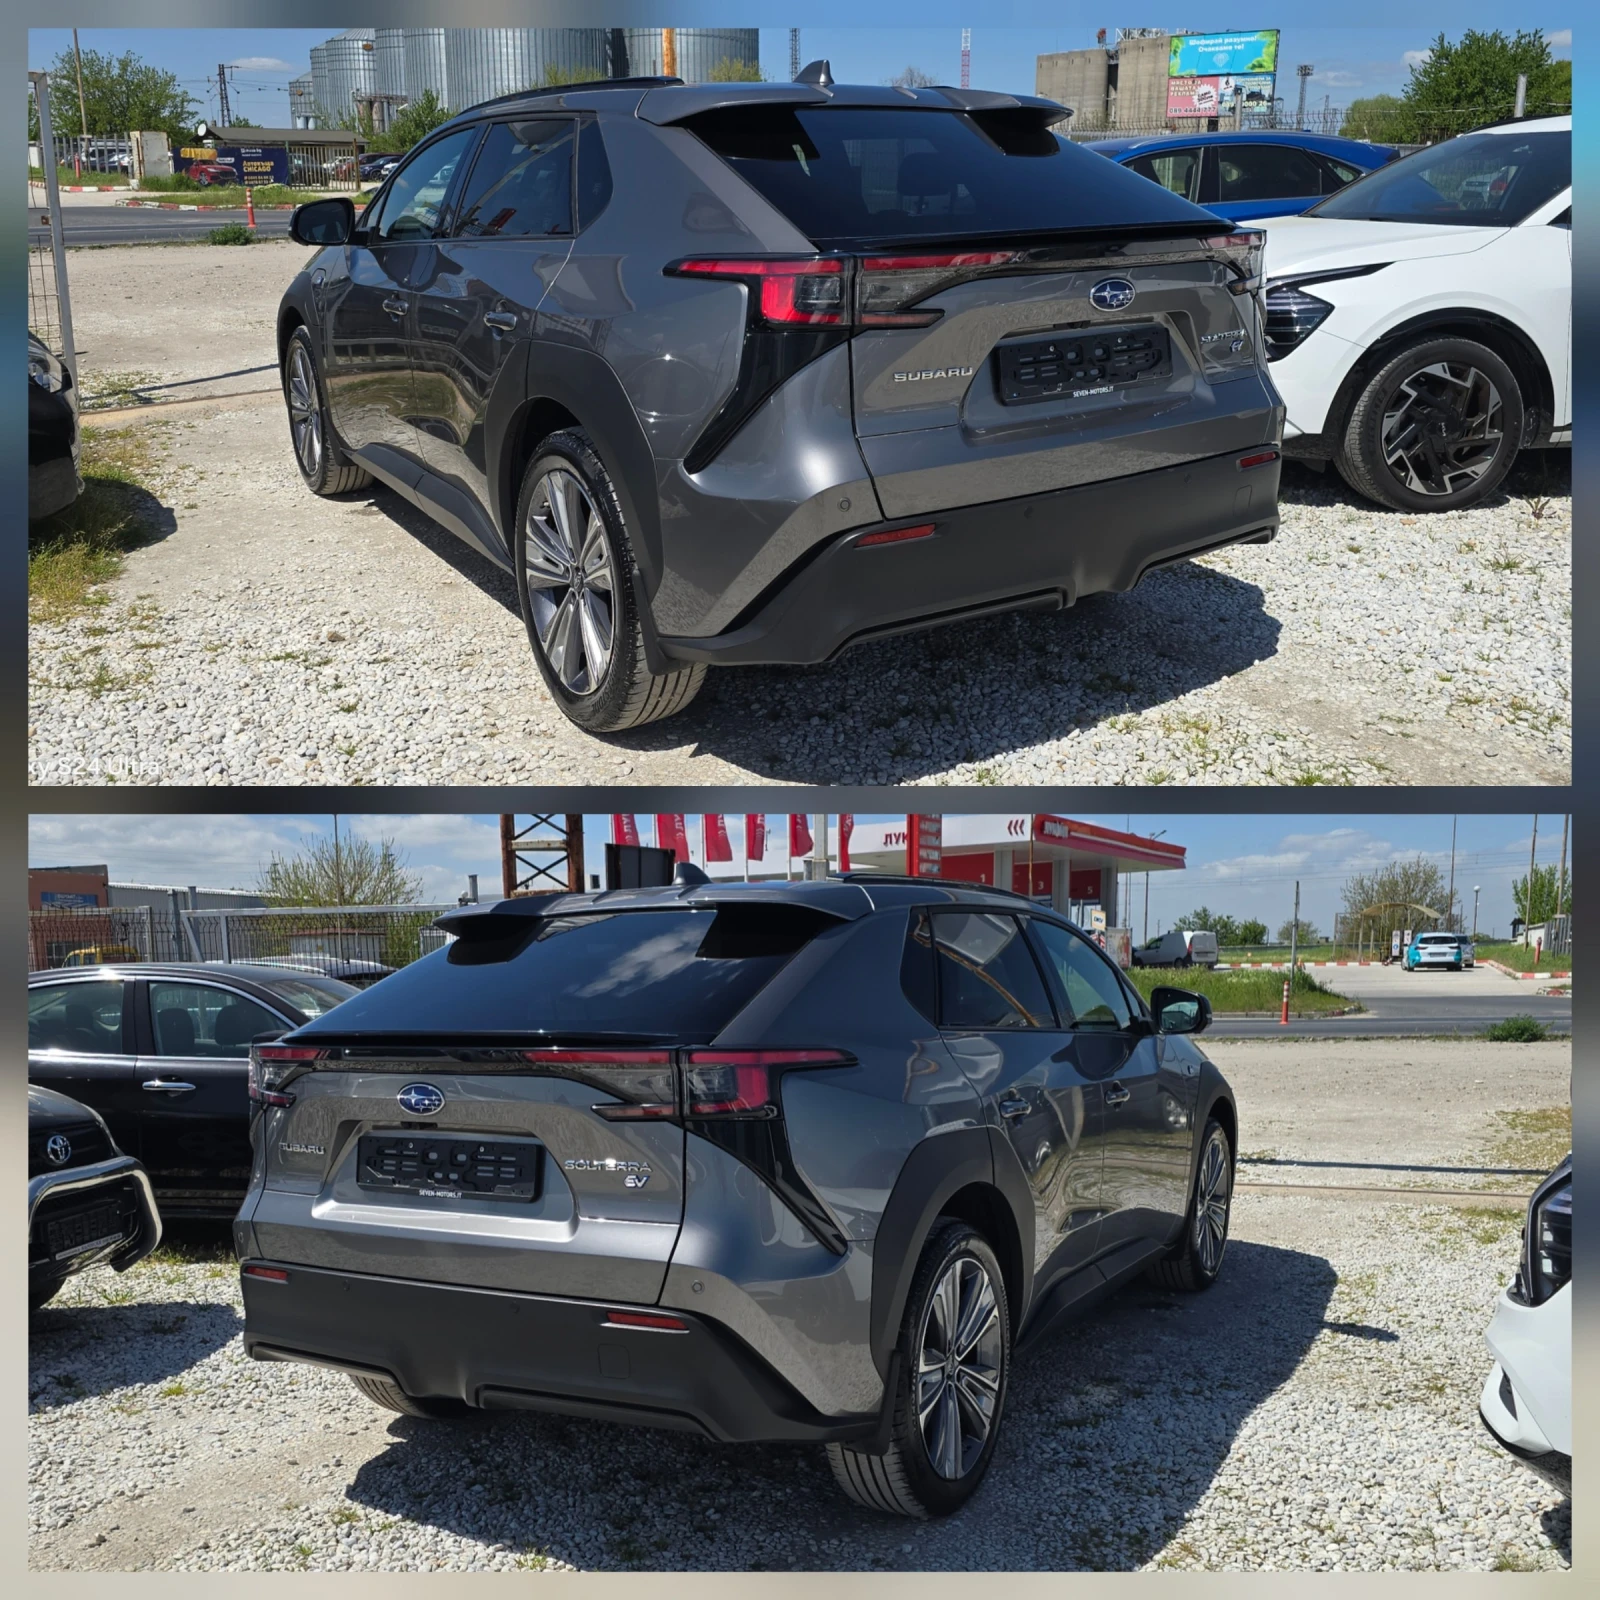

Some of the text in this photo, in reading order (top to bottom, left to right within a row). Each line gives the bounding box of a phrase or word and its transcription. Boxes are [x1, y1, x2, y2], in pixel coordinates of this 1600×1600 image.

[893, 367, 973, 382] SUBARU
[1072, 385, 1114, 398] SEVEN-MOTORS.IT
[1037, 881, 1045, 890] 3
[564, 1158, 653, 1172] SOLTERRA
[624, 1175, 650, 1188] EV
[419, 1189, 462, 1198] SEVEN-MOTORS.IT
